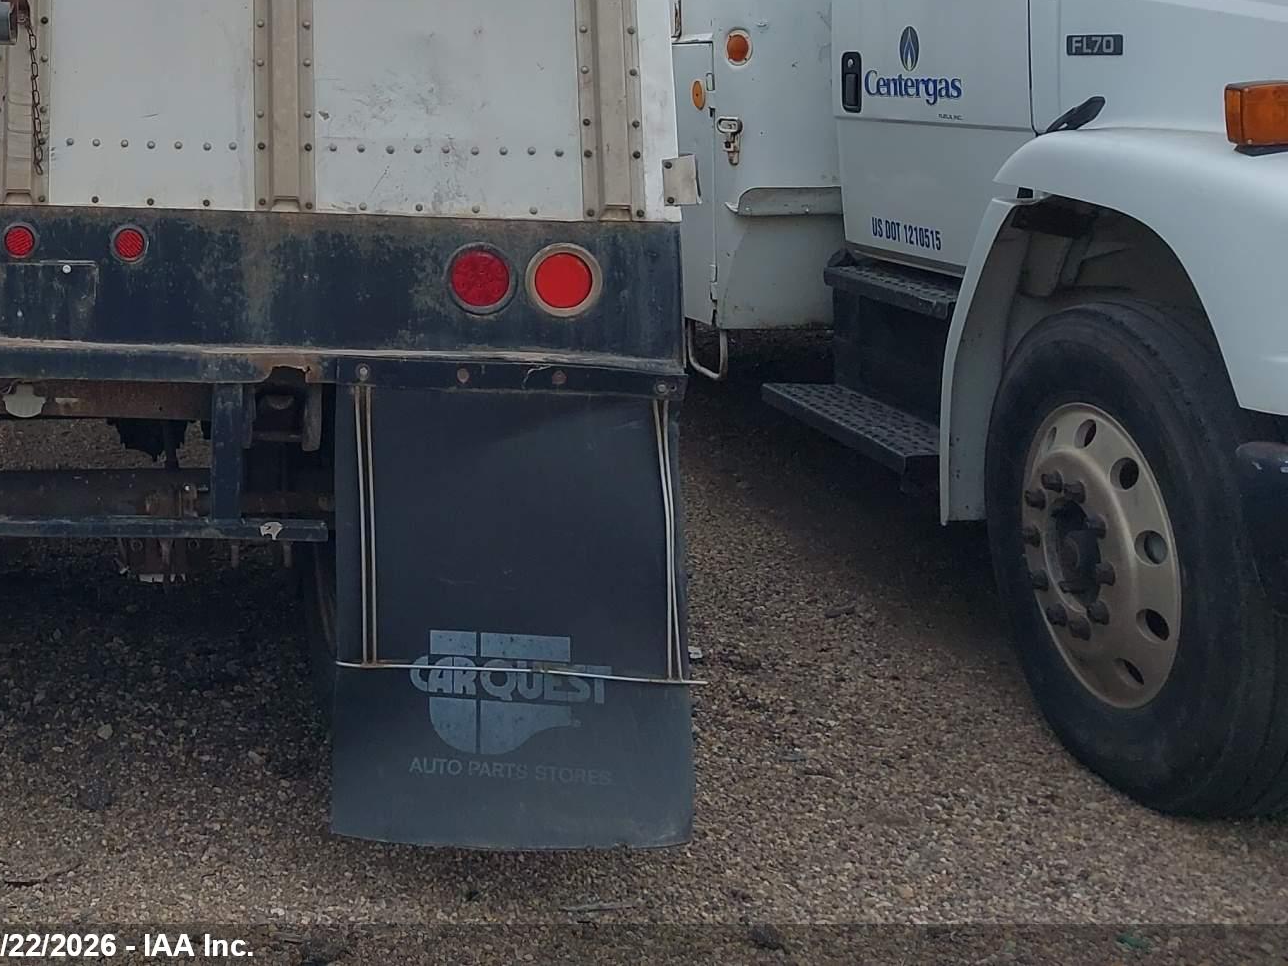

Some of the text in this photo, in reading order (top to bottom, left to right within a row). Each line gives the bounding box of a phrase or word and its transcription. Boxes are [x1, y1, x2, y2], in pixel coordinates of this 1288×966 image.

[1072, 36, 1114, 53] FL70
[864, 69, 962, 106] Centergas
[872, 217, 942, 251] US DOT 1210515
[409, 655, 613, 705] CARQUEST
[409, 757, 612, 786] AUTO PARTS STORES
